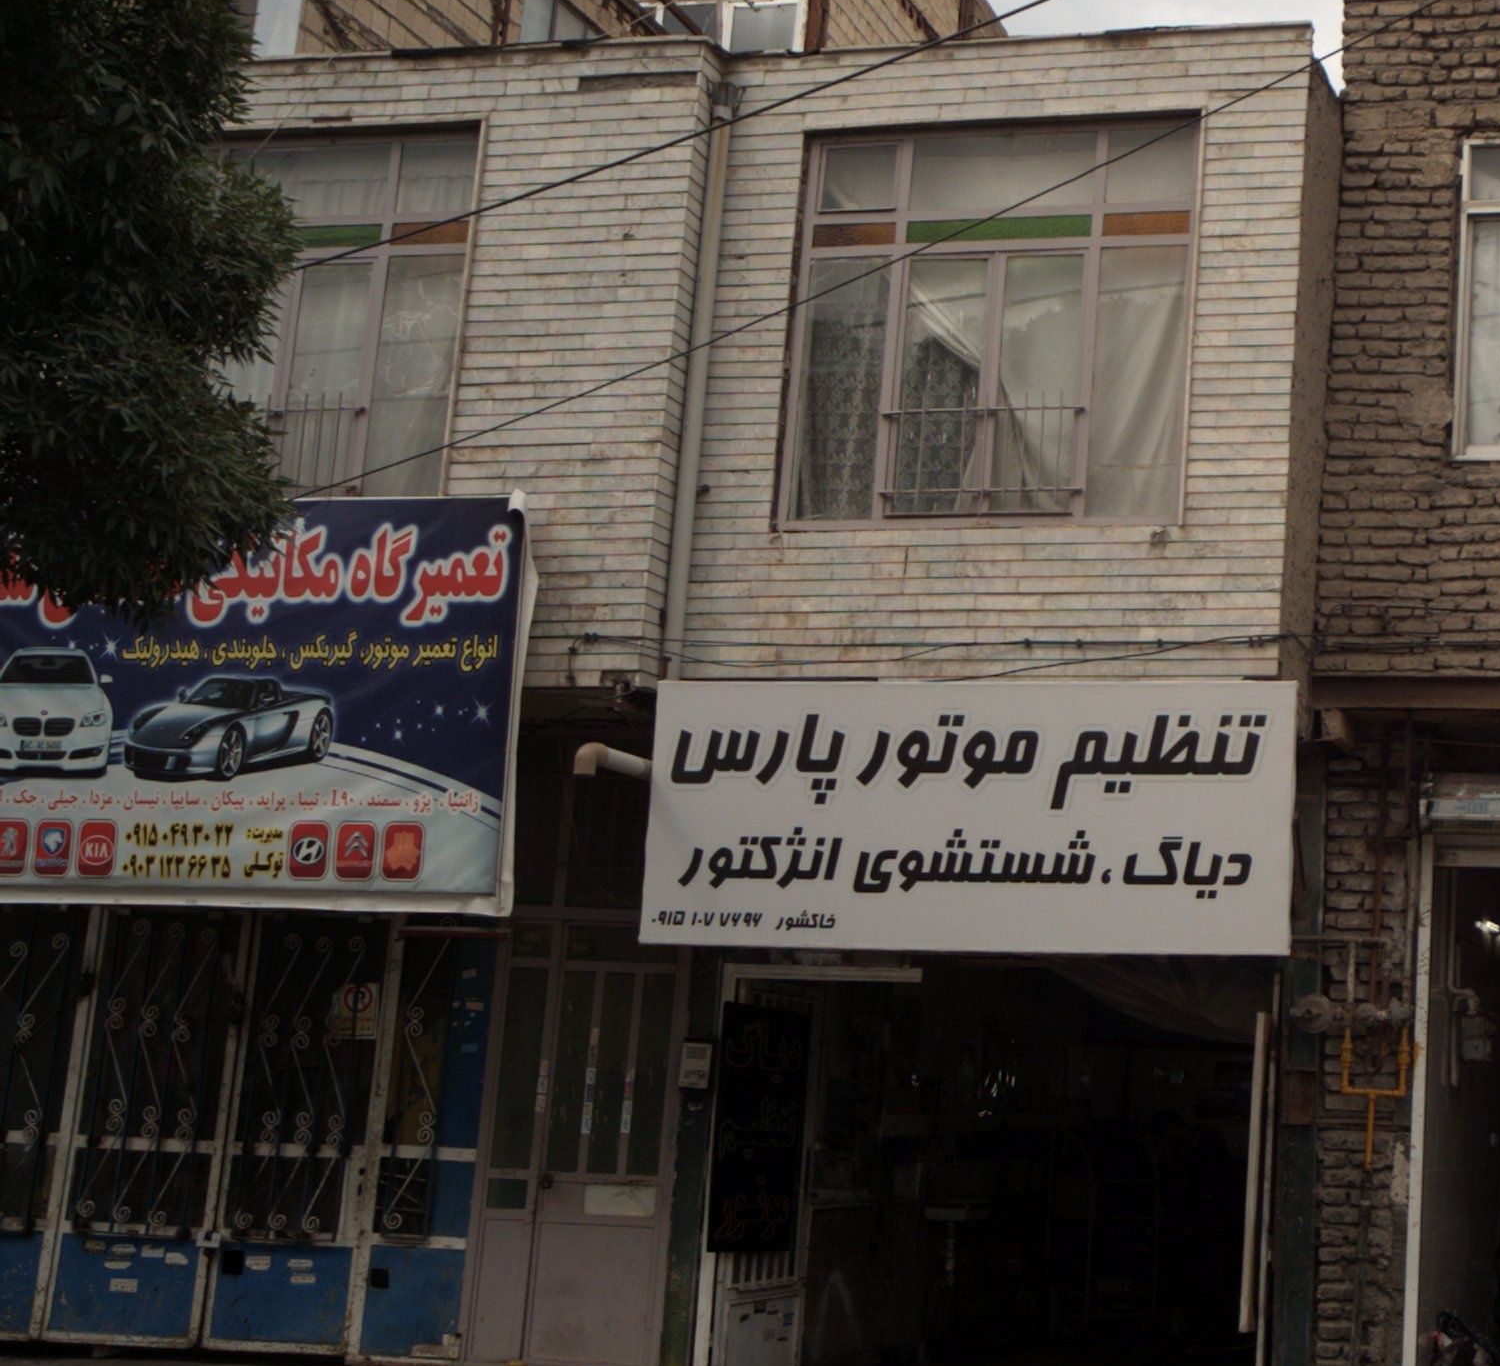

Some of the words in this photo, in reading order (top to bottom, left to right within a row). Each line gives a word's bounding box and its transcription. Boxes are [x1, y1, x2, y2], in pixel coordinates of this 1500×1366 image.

[121, 635, 200, 669] هیدرولیک
[412, 637, 457, 668] تعمیر
[460, 633, 498, 672] انواع
[670, 713, 845, 805] پارس
[856, 714, 1039, 789] موتور
[1050, 714, 1267, 810] تنظیم
[84, 842, 108, 859] KIA
[125, 822, 158, 846] ۰۹۱۵
[243, 851, 284, 879] توکلی
[677, 826, 843, 889] انژکتور
[852, 828, 1096, 894] شستشوی
[651, 910, 686, 926] ۰۹۱۵
[691, 911, 715, 926] ۱۰۷
[775, 909, 836, 931] خاکشور
[725, 1018, 801, 1084] دیاگ
